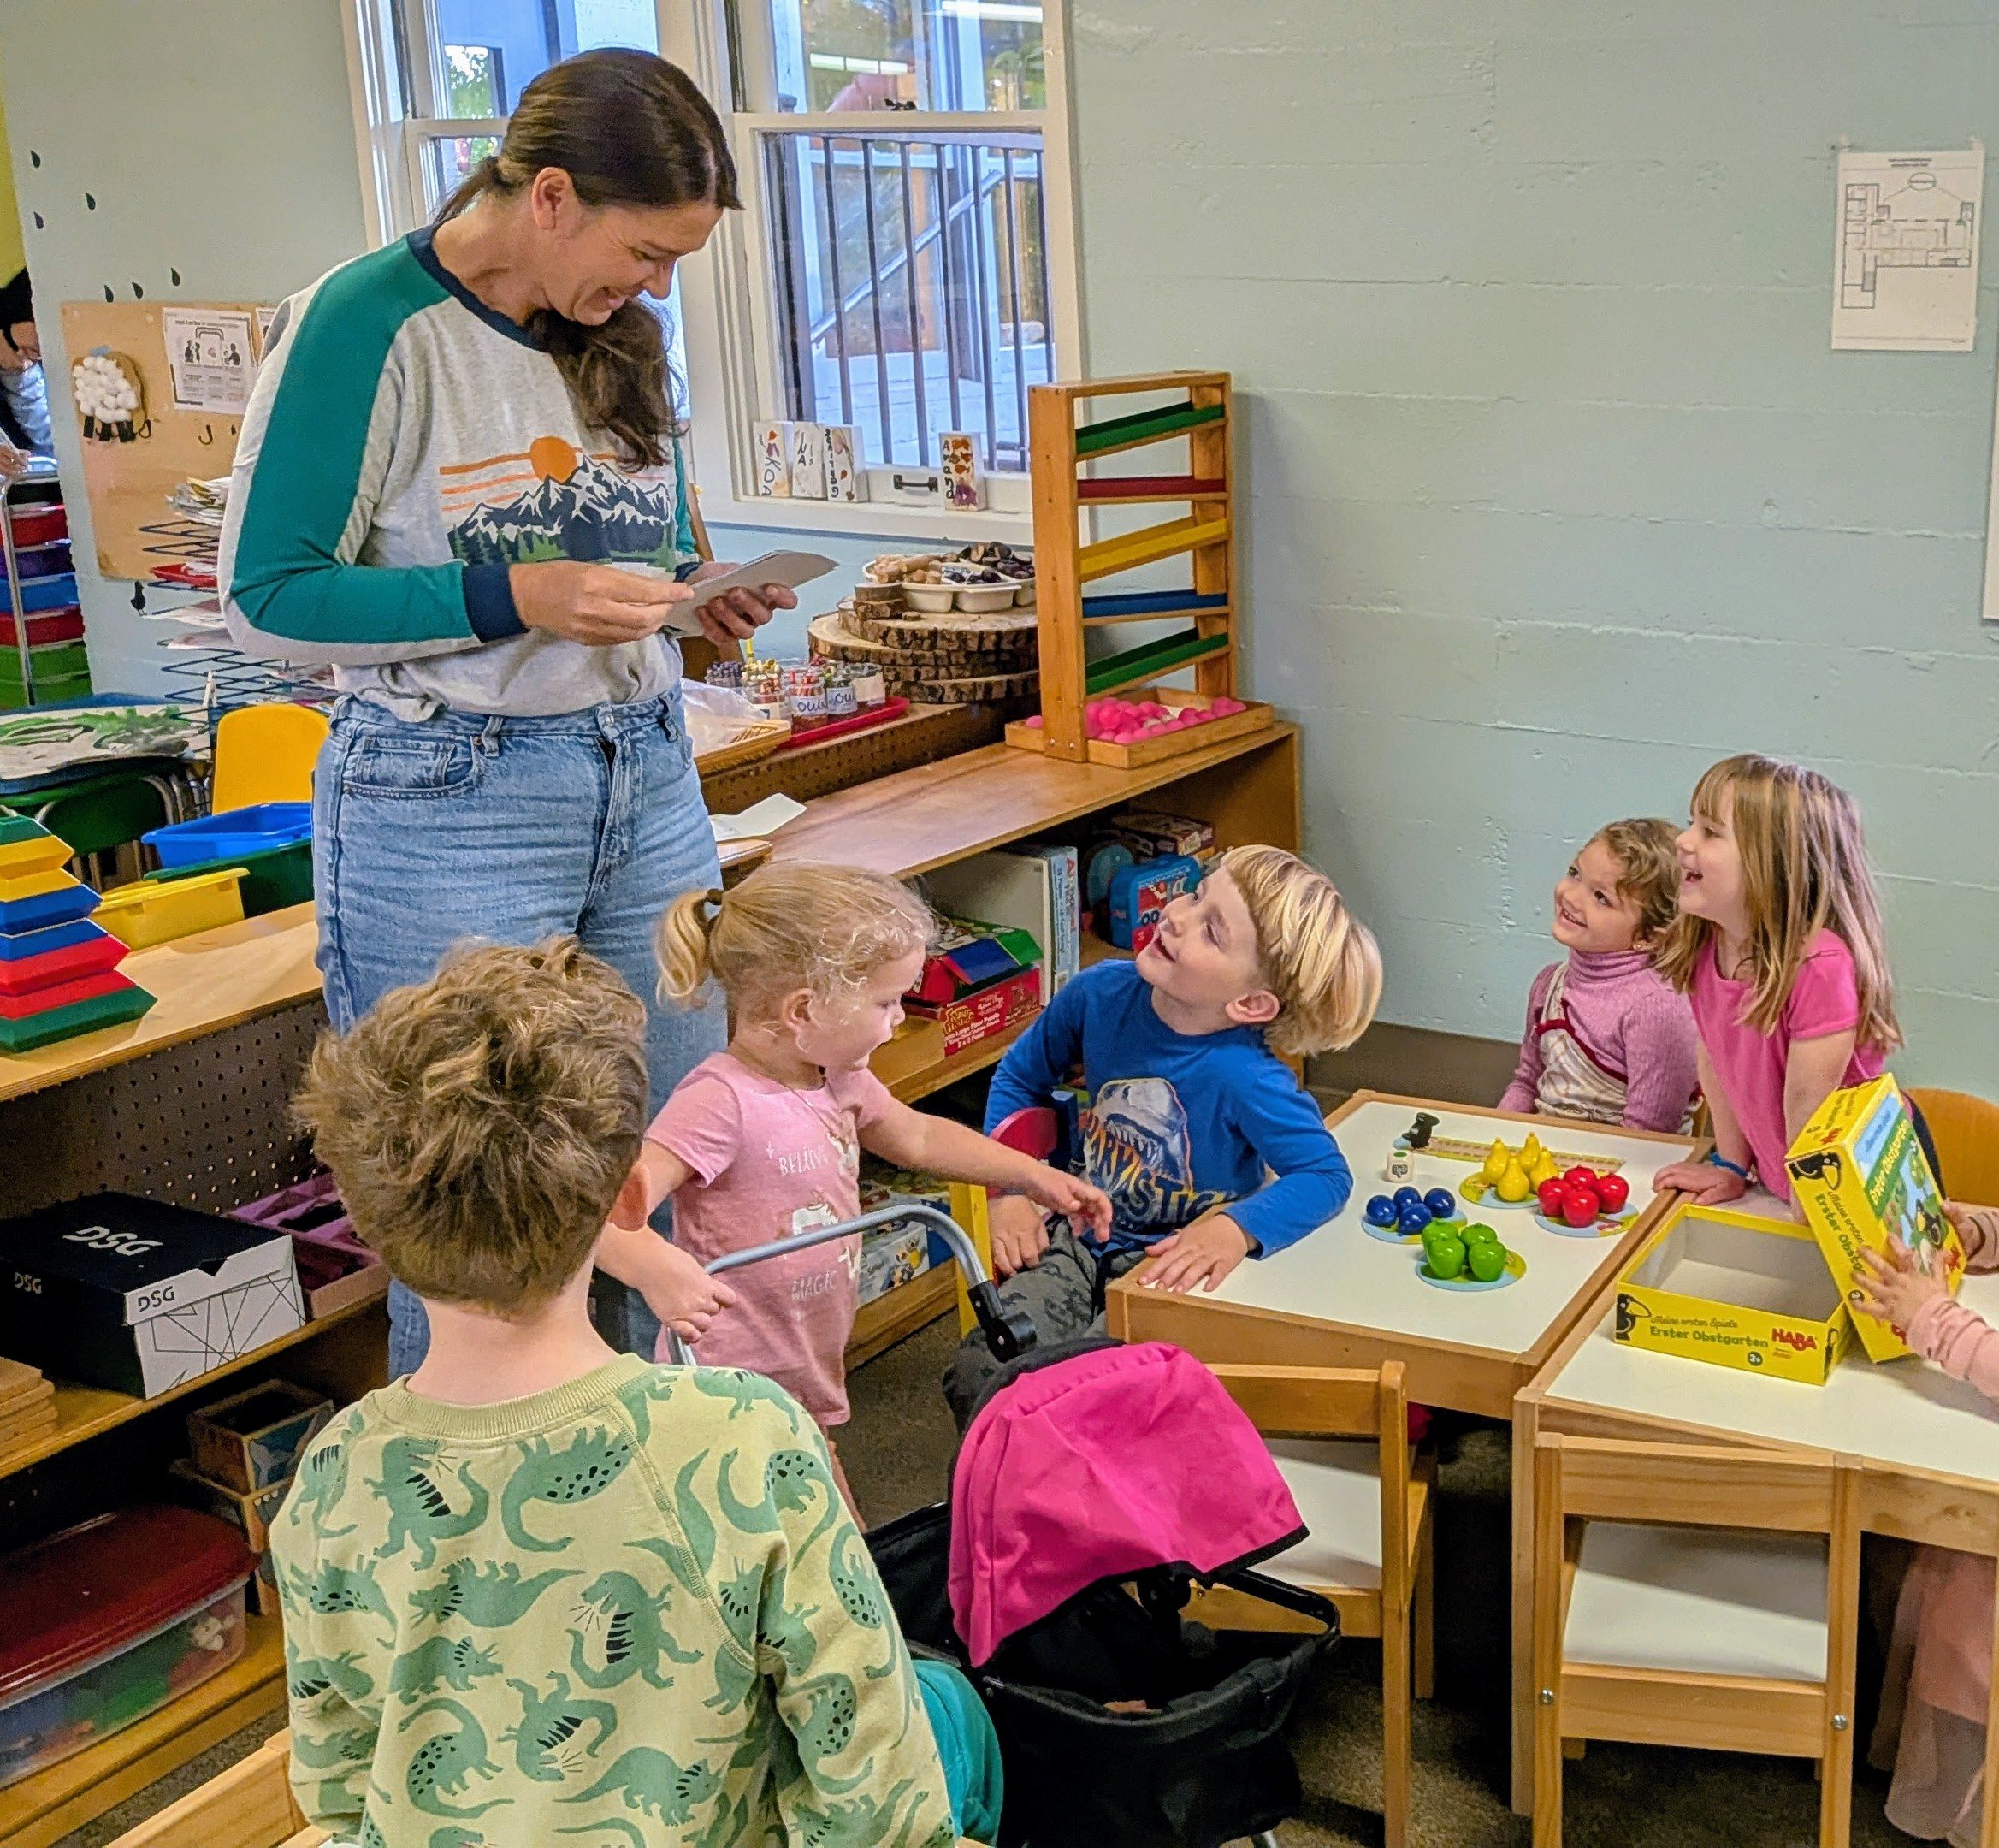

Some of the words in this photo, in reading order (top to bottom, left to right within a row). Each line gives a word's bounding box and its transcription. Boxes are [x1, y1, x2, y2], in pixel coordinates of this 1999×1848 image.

[1814, 1194, 1842, 1231] Erster
[62, 1225, 164, 1256] DSG
[14, 1272, 42, 1294] DSG
[792, 1270, 839, 1300] MAGIC
[138, 1286, 175, 1312] DSG
[1681, 1318, 1709, 1328] ersten
[1709, 1318, 1739, 1329] Spiele
[1650, 1326, 1689, 1339] Erster
[1692, 1330, 1769, 1349] Obstgarten
[1771, 1328, 1818, 1352] HABA
